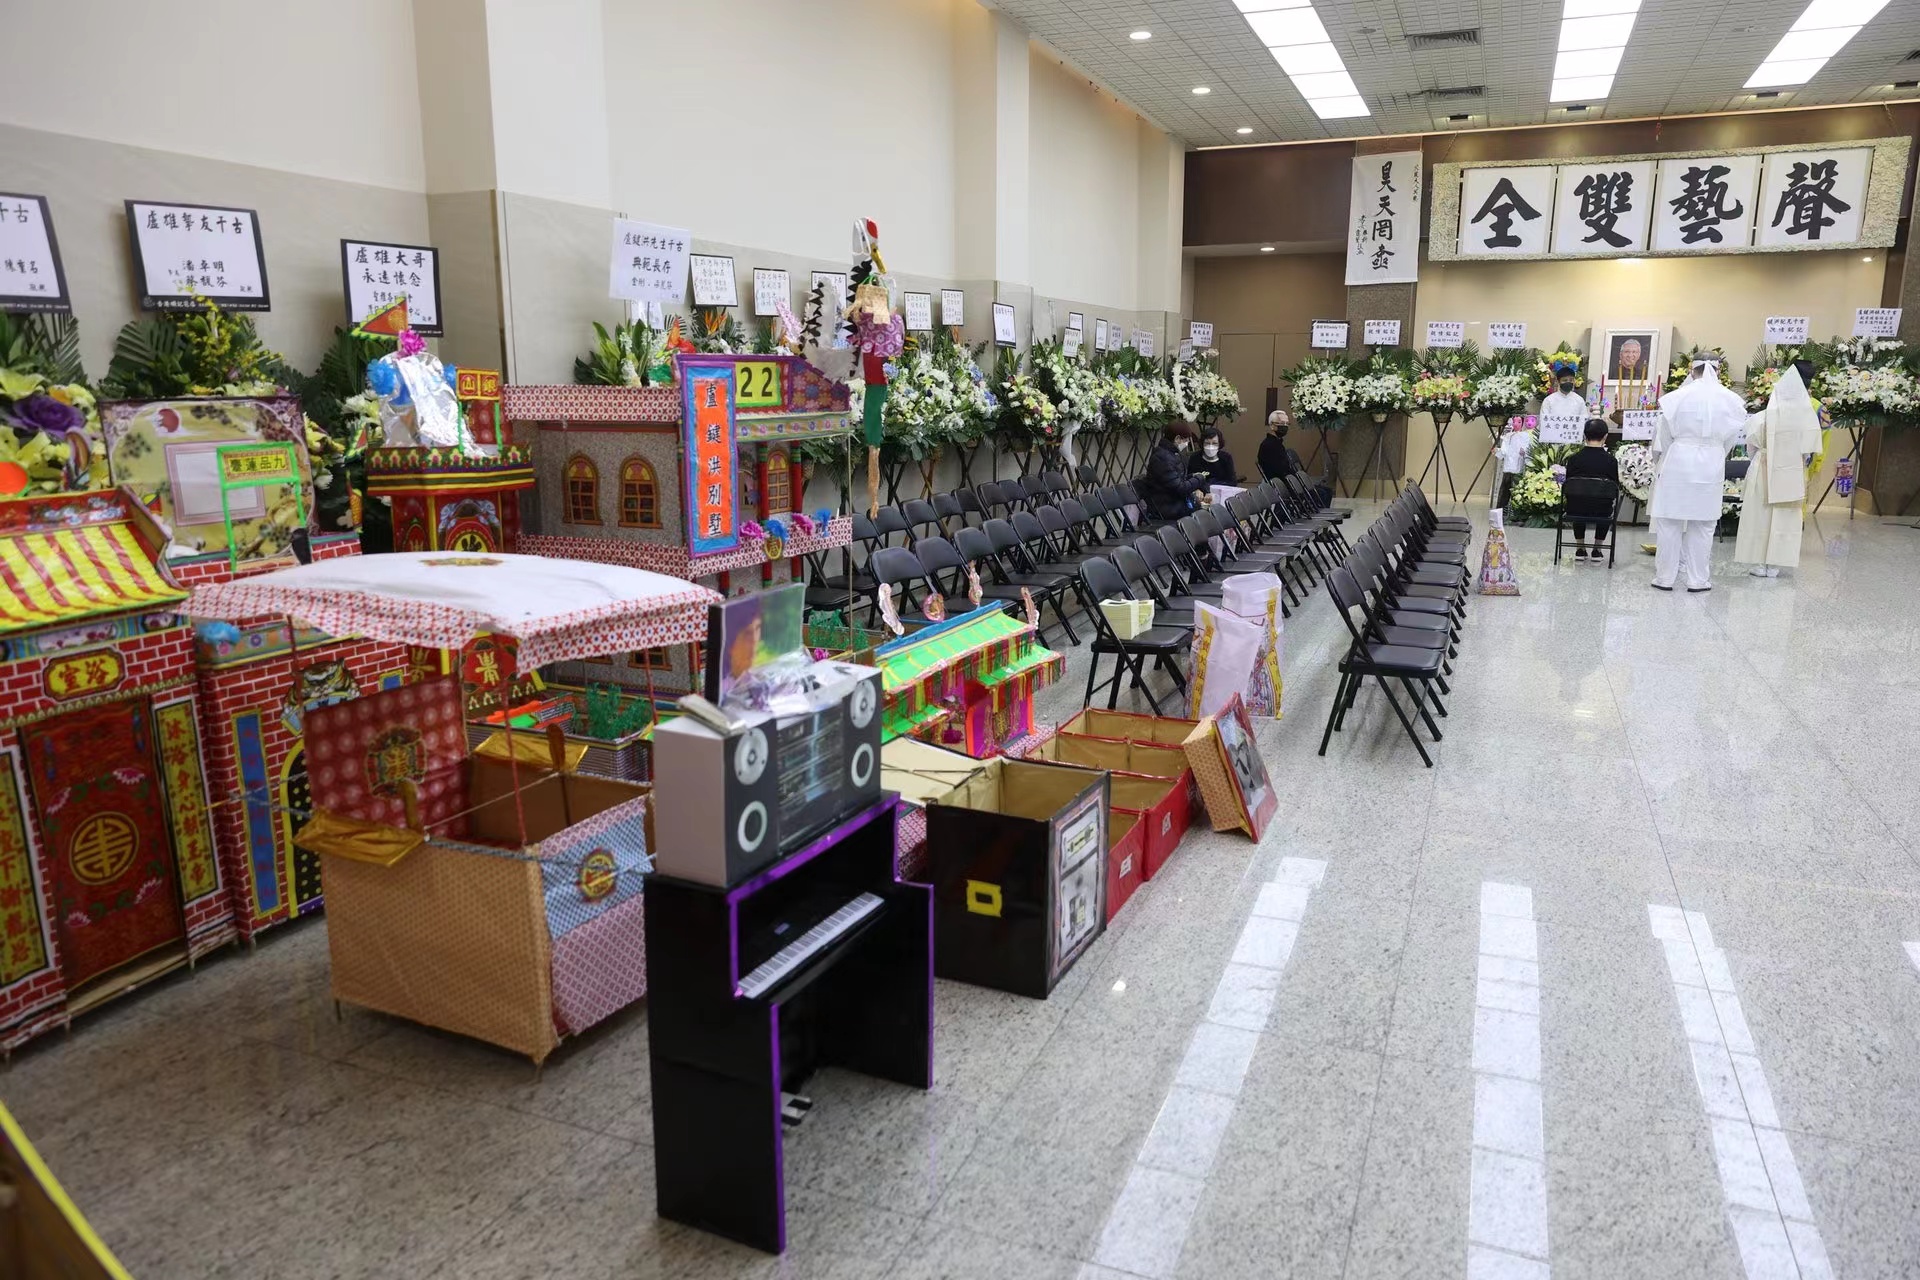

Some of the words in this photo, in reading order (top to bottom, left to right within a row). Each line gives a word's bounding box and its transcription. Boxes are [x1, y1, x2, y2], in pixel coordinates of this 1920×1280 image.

[355, 246, 425, 268] 盧雄大哥
[632, 256, 671, 274] 典範長存
[362, 268, 421, 287] 永遠懷念
[704, 384, 722, 538] 盧鍵洪別墅
